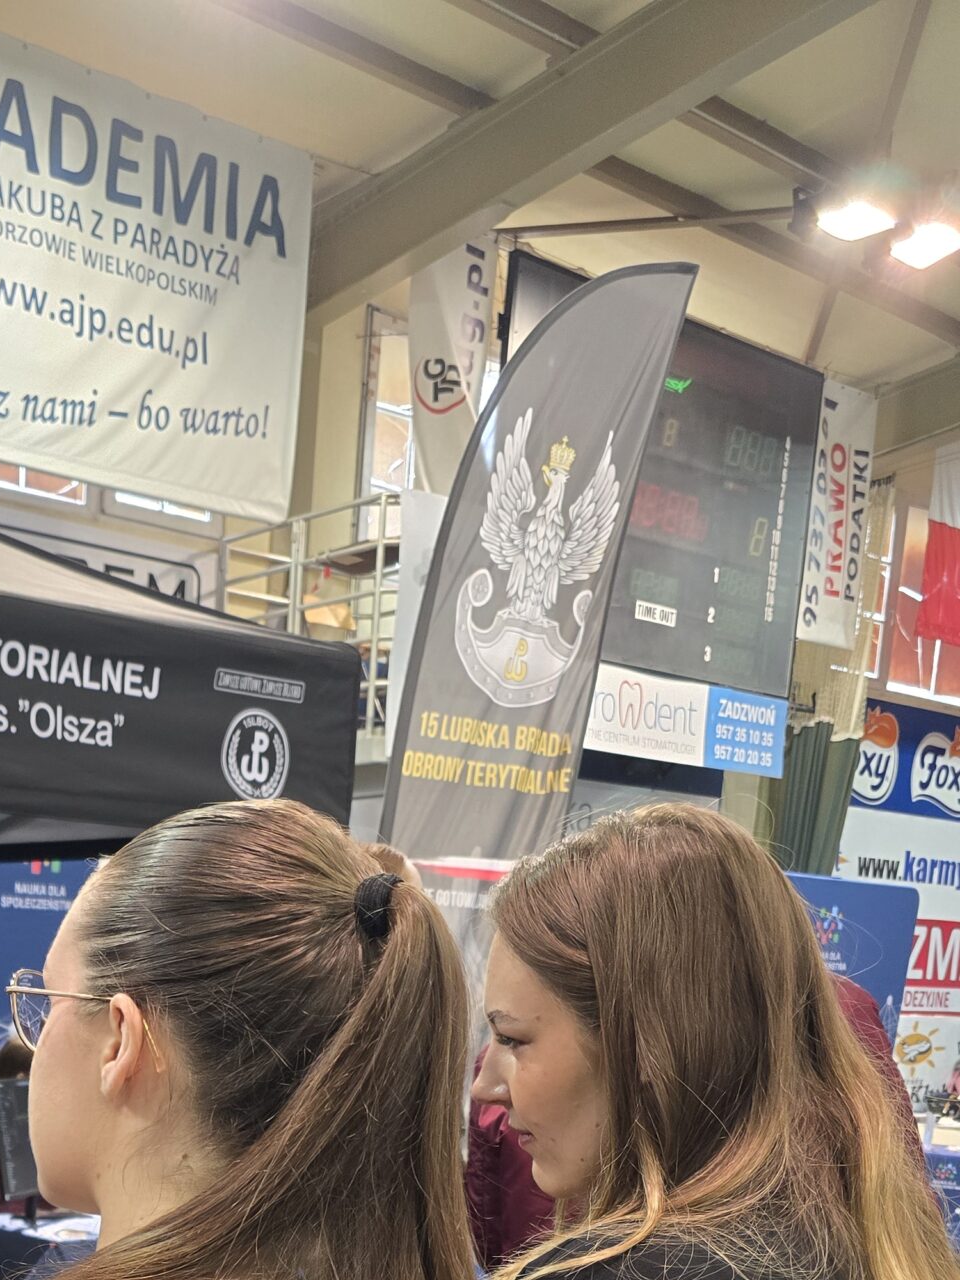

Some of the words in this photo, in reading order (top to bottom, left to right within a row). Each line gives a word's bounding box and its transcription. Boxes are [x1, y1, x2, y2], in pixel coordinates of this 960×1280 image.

[89, 209, 104, 241] Z
[112, 217, 241, 286] PARADYŻA
[81, 245, 219, 307] WIELKOPOLSKIM
[21, 388, 98, 427] nami
[137, 389, 171, 430] bo
[179, 405, 271, 440] warto!
[824, 442, 847, 598] PRAWO
[843, 449, 870, 602] PODATKI
[713, 567, 720, 583] 1
[637, 603, 657, 618] TIME
[659, 609, 675, 623] OUT
[707, 606, 716, 623] 2
[704, 645, 712, 662] 3
[718, 699, 777, 726] ZADZWOŃ
[421, 711, 439, 738] 15
[440, 716, 509, 749] LUBUSKA
[715, 724, 733, 739] 957
[735, 728, 748, 741] 35
[750, 731, 759, 743] 10
[761, 733, 774, 746] 35
[402, 750, 465, 783] OBRONY
[714, 745, 732, 759] 957
[733, 748, 746, 761] 20
[747, 751, 759, 764] 20
[760, 753, 772, 766] 35
